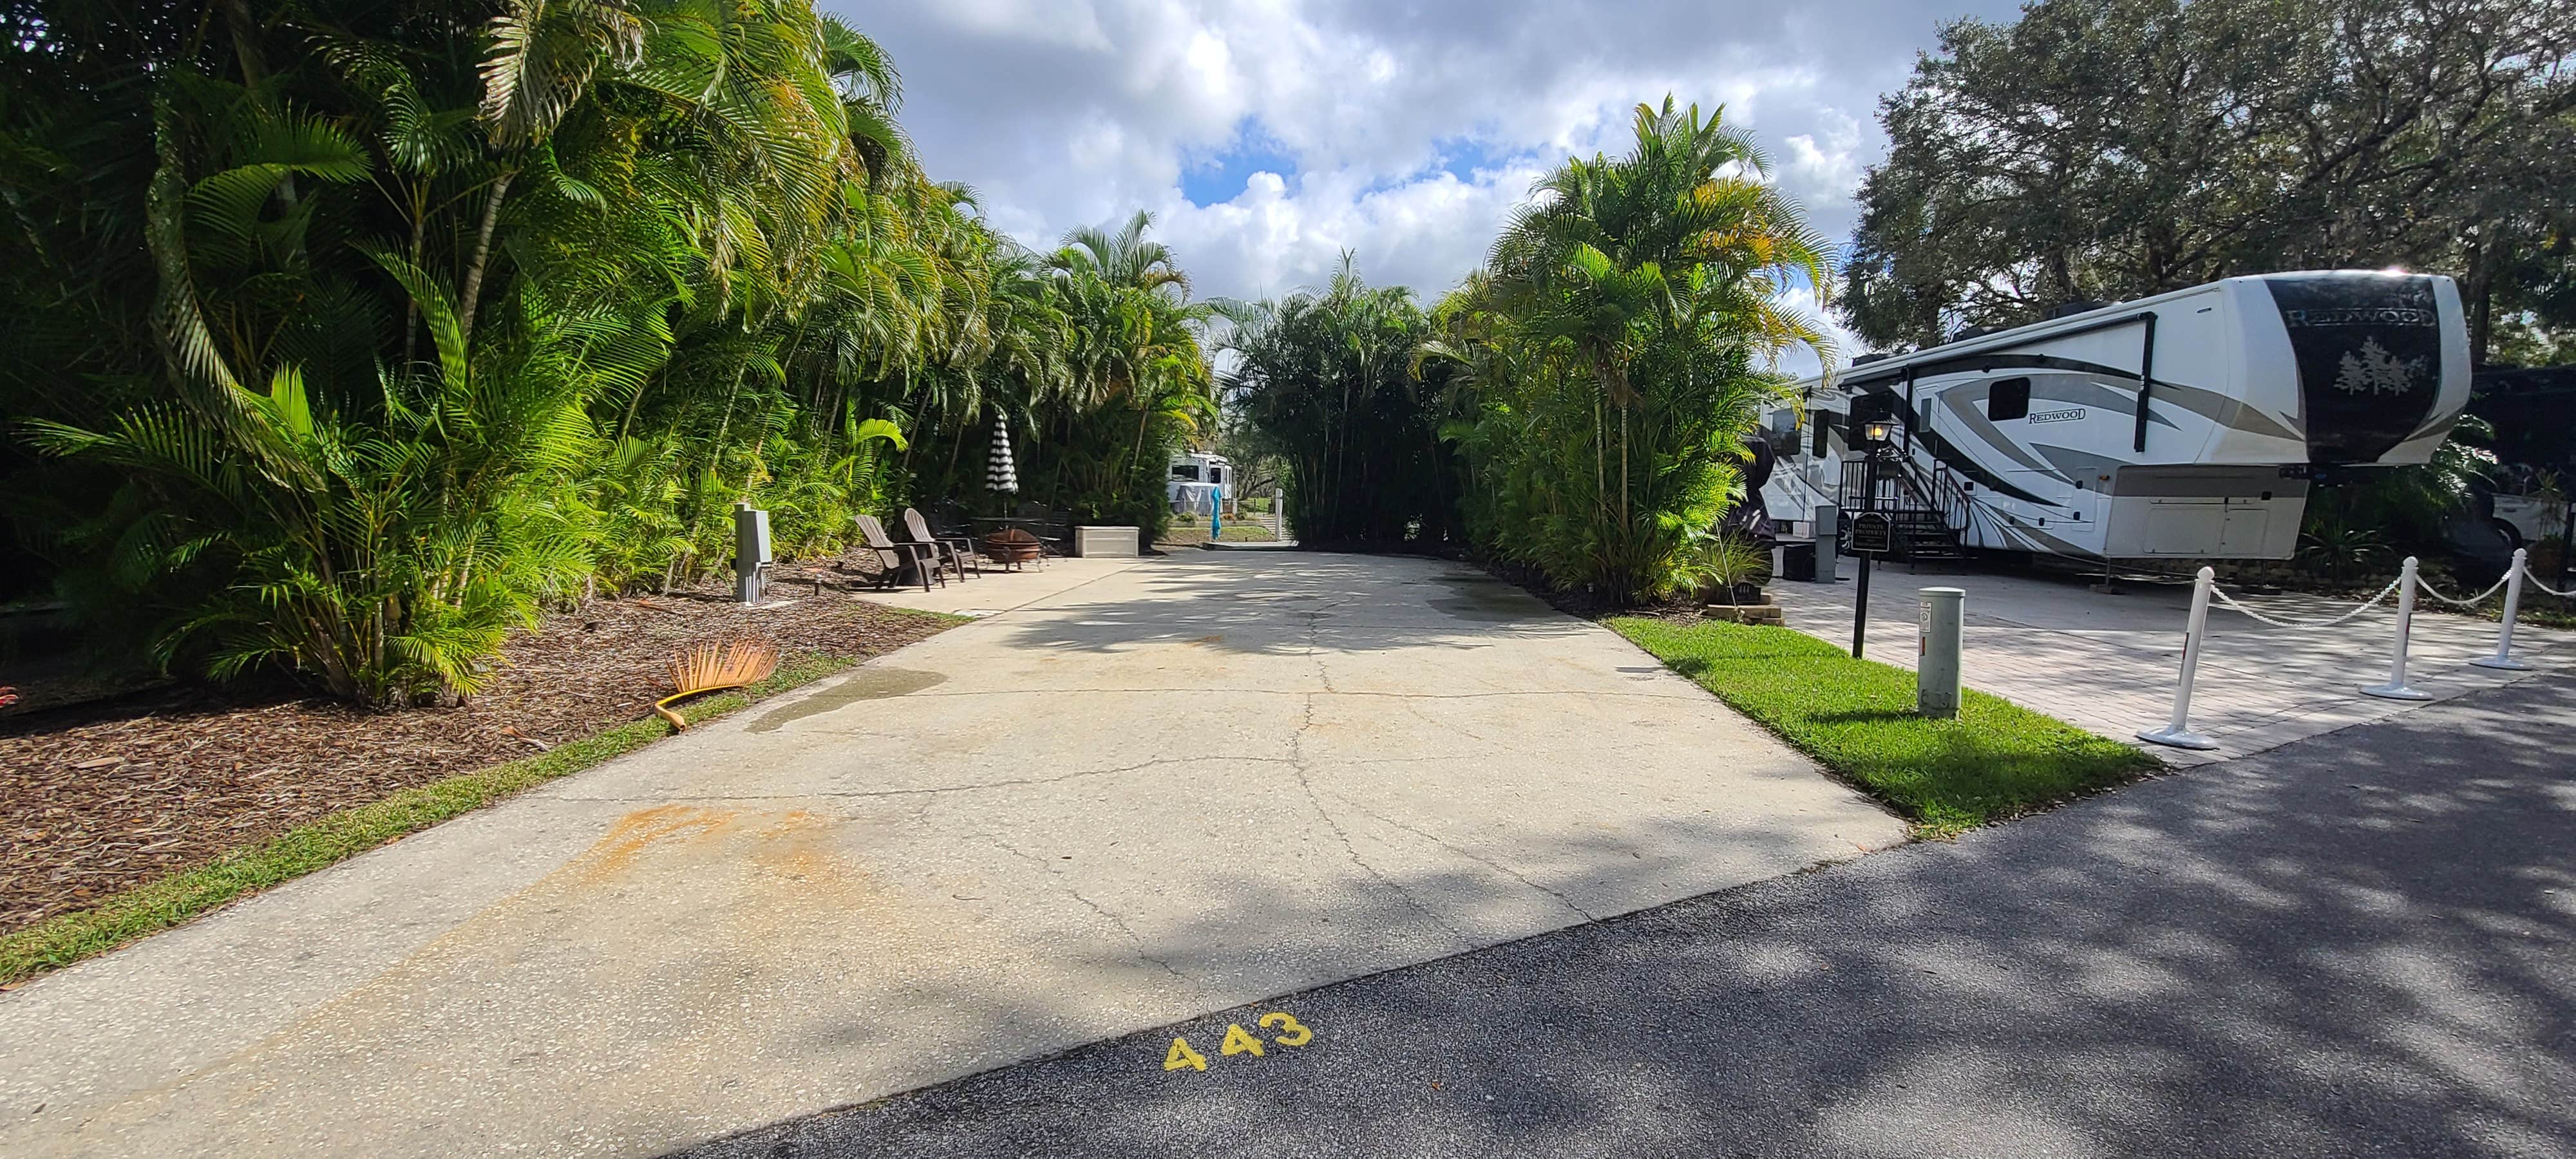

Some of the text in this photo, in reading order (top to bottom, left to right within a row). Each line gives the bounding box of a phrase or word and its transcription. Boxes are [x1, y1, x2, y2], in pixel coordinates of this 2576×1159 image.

[2286, 308, 2436, 327] REDWOOD
[2029, 408, 2086, 424] REDWOOD
[1163, 1012, 1312, 1072] 443
